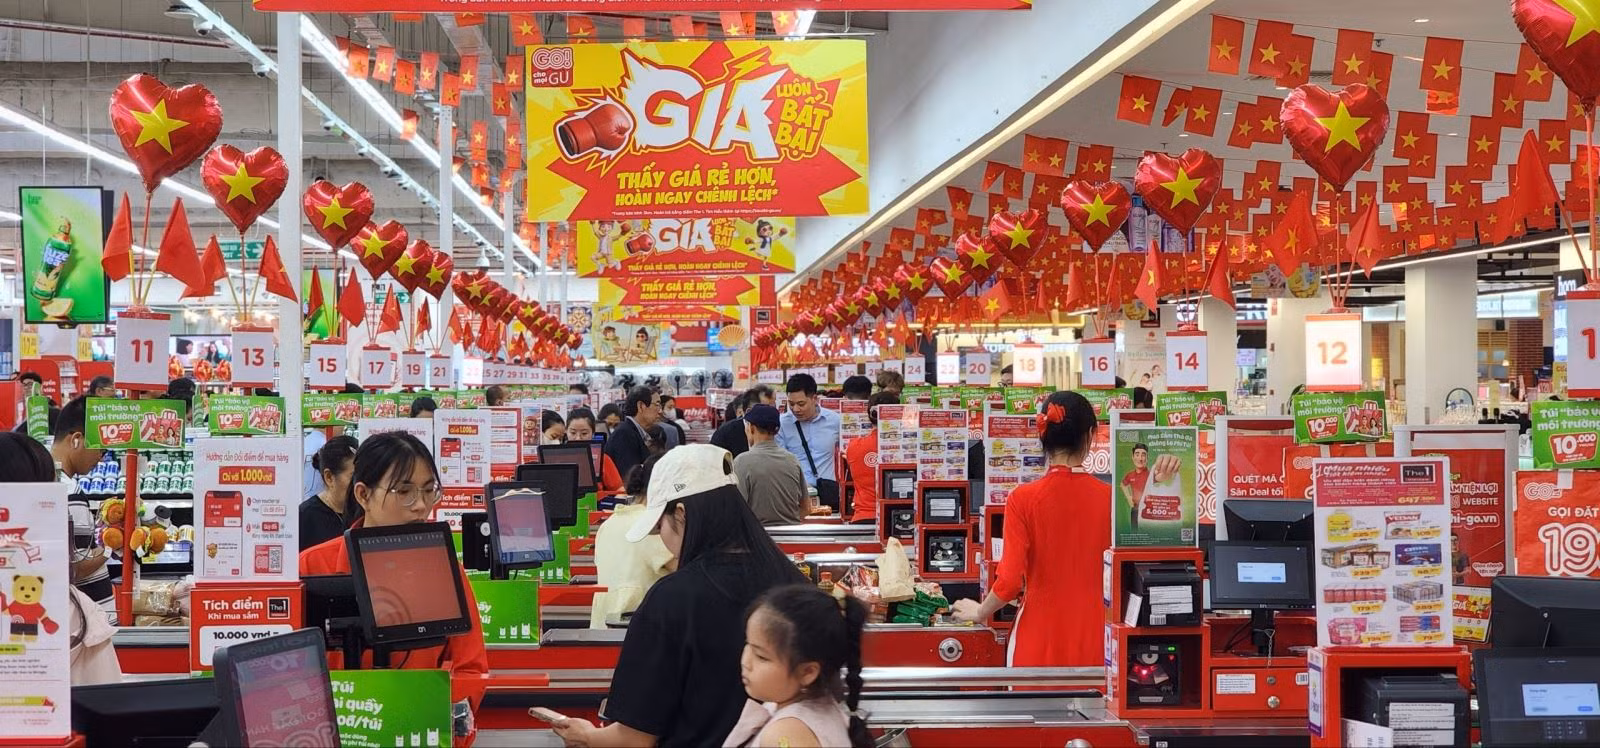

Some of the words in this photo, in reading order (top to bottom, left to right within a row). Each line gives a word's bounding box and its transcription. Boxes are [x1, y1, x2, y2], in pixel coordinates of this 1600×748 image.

[532, 48, 574, 70] GO!
[549, 71, 569, 84] GU
[776, 78, 811, 97] LUÔN
[622, 52, 788, 159] GIÁ
[781, 94, 829, 130] BẤT
[775, 122, 817, 155] BẠI
[617, 162, 665, 189] THẤY
[669, 164, 702, 187] GIÁ
[707, 162, 729, 185] RẺ
[735, 167, 776, 186] HƠN,
[616, 188, 651, 206] HOÀN
[655, 191, 692, 205] NGAY
[696, 187, 737, 203] CHÊNH
[628, 262, 643, 271] THẤY
[641, 279, 664, 291] THẤY
[666, 280, 681, 291] GIÁ
[684, 280, 694, 291] RẺ
[131, 339, 154, 363] 11
[242, 348, 264, 366] 13
[1317, 342, 1347, 365] 12
[317, 358, 337, 372] 15
[1019, 358, 1035, 372] 18
[1089, 356, 1108, 372] 16
[1174, 352, 1199, 370] 14
[368, 361, 384, 375] 17
[407, 364, 420, 375] 19
[434, 366, 446, 377] 21
[907, 365, 921, 375] 24
[969, 363, 986, 374] 20
[93, 404, 106, 412] Túi
[1299, 400, 1311, 408] Túi
[90, 413, 106, 421] môi
[1298, 408, 1312, 416] môi
[1540, 408, 1558, 418] Túi
[1537, 420, 1558, 431] môi
[1233, 474, 1260, 484] QUÉT
[1262, 474, 1277, 483] MÃ
[1230, 488, 1246, 496] Săn
[1250, 488, 1269, 496] Deal
[1463, 482, 1480, 495] TIỆN
[1483, 483, 1498, 495] LỢI
[1548, 506, 1570, 518] GỌI
[1575, 505, 1599, 519] ĐẶT
[1451, 513, 1497, 525] hi-go.vn
[1538, 522, 1600, 576] 19
[202, 599, 229, 610] Tích
[232, 596, 263, 610] điểm
[208, 612, 222, 620] Khi
[242, 611, 259, 619] sắm
[213, 631, 248, 639] 10.000
[251, 631, 271, 639] vnd
[346, 698, 383, 715] quầy
